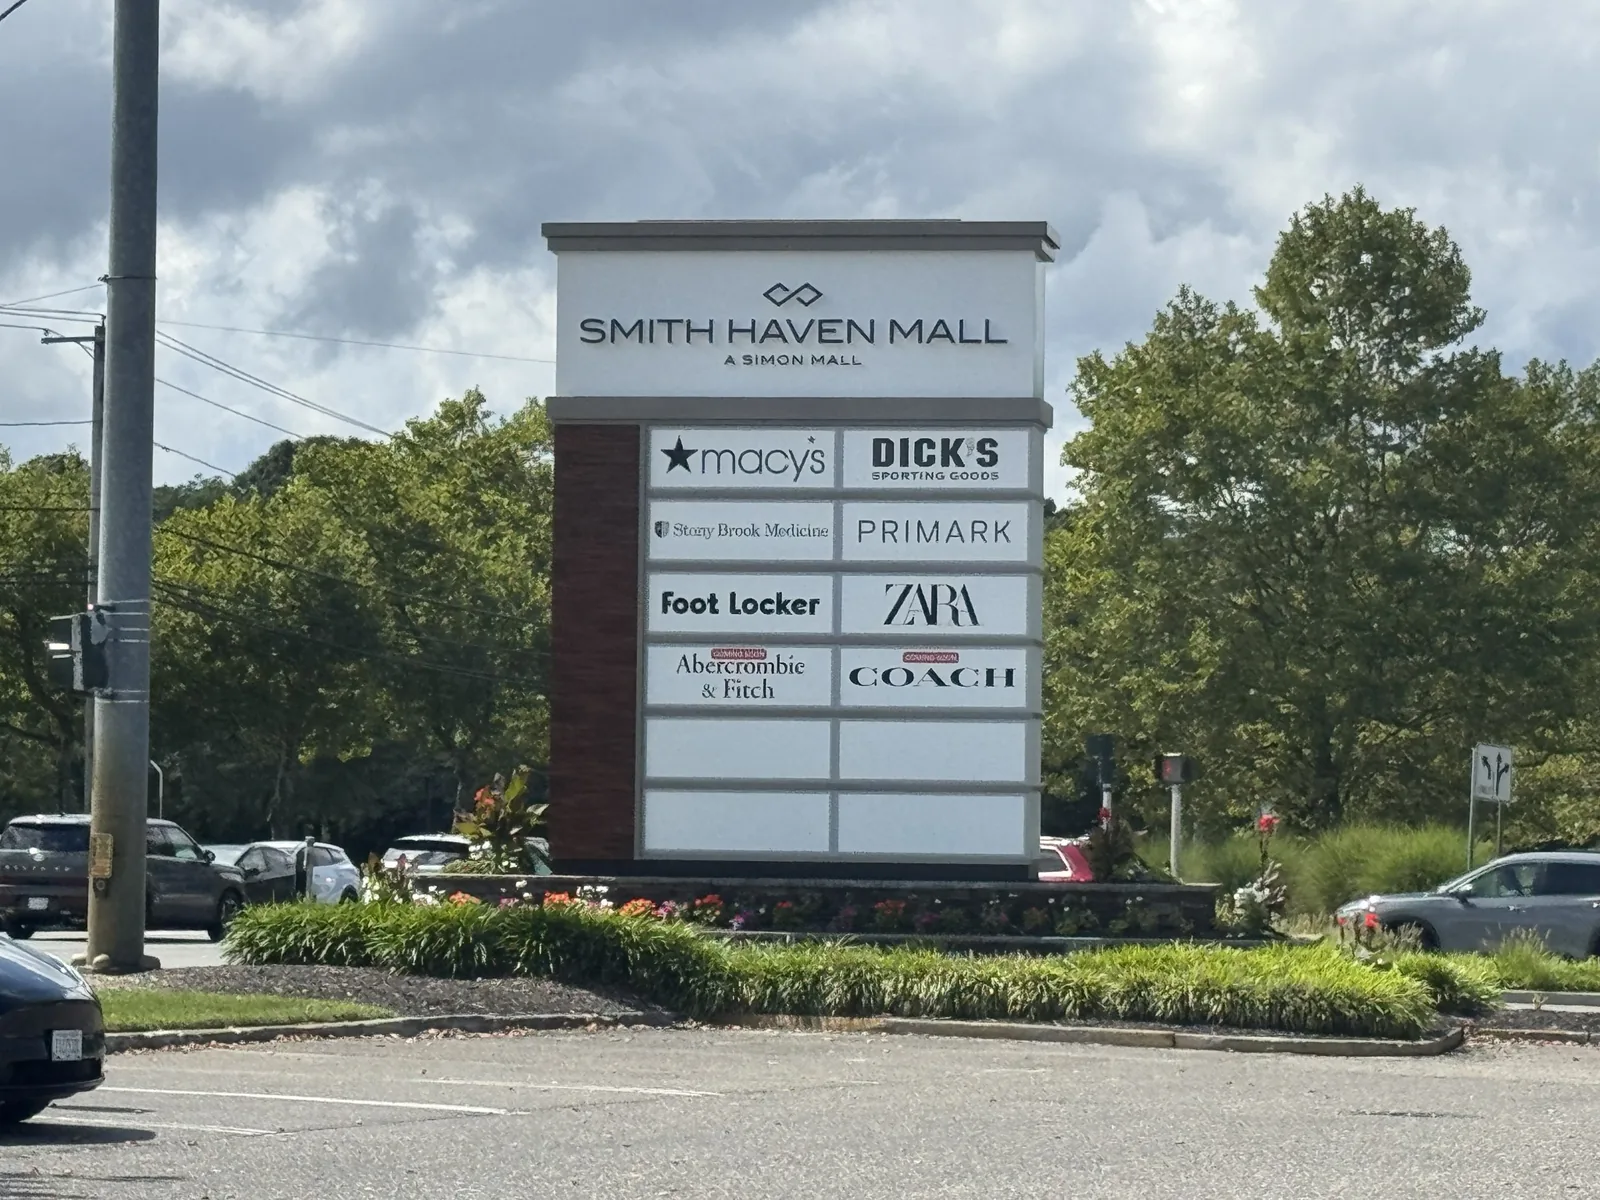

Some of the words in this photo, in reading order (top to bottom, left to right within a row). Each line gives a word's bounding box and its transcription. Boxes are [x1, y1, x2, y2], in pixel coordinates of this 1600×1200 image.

[580, 318, 714, 344] SMITH
[728, 318, 875, 345] HAVEN
[889, 318, 1008, 345] MALL
[724, 354, 736, 366] A
[742, 354, 804, 366] SIMON
[811, 354, 862, 366] MALL
[701, 435, 825, 483] macy's
[872, 437, 999, 468] DICK'S
[871, 471, 946, 481] SPORTING
[949, 471, 1000, 481] GOODS
[673, 523, 715, 540] Stony
[718, 523, 760, 538] Brook
[765, 523, 829, 538] Medicine
[858, 520, 1012, 544] PRIMARK
[661, 591, 720, 615] Foot
[729, 591, 820, 616] Locker
[883, 583, 984, 627] ZARA
[676, 653, 805, 675] Abercrombie
[702, 683, 717, 699] &
[723, 678, 775, 699] Fitch
[849, 667, 1016, 688] COACH
